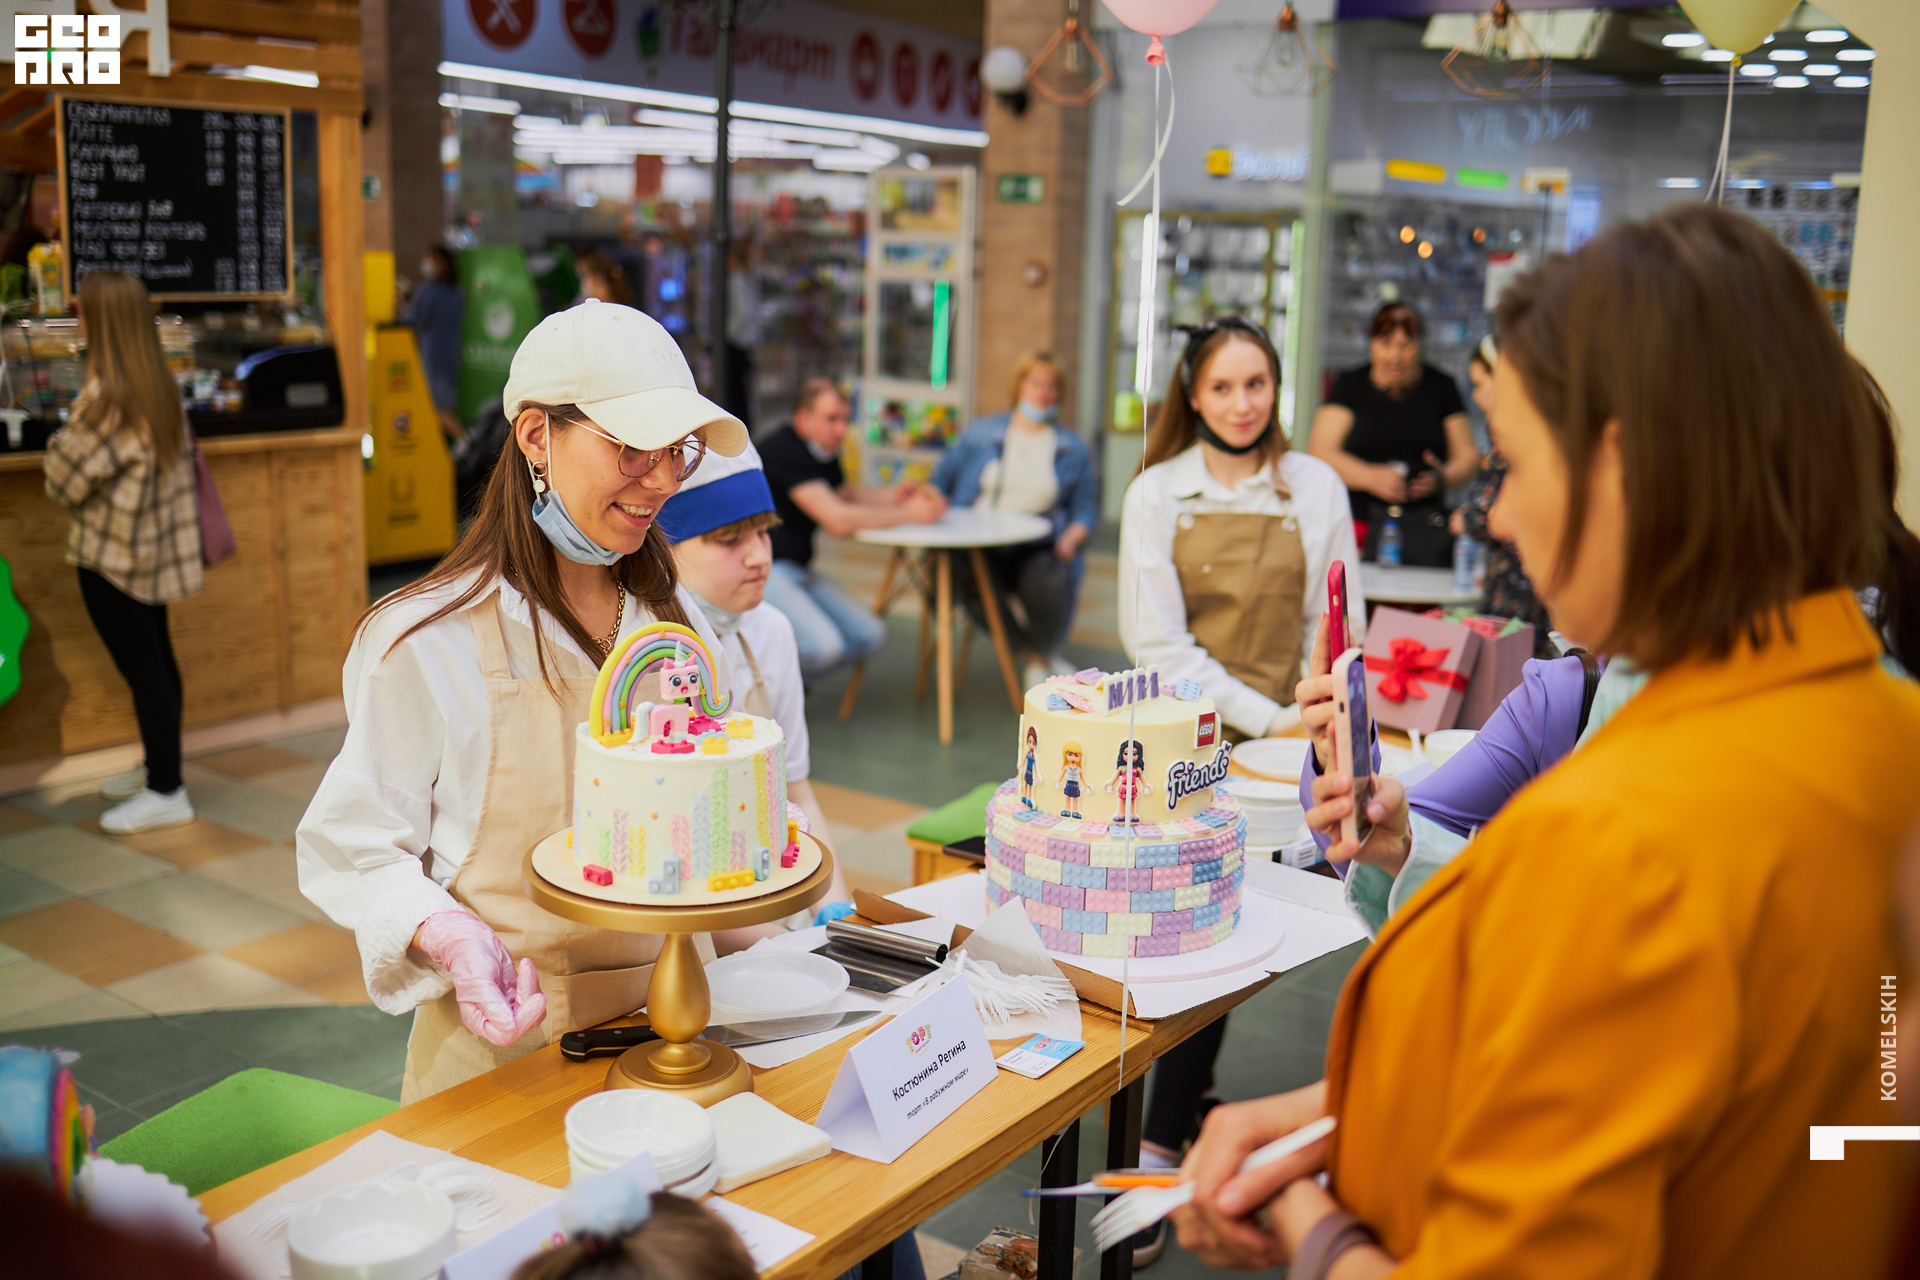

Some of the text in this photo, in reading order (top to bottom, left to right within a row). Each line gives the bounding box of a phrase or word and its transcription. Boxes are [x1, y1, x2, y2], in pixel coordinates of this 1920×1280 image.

[1199, 722, 1215, 737] LEGO
[1168, 748, 1230, 810] Friends
[892, 1061, 939, 1101] Костюнина
[938, 1040, 967, 1067] Регина
